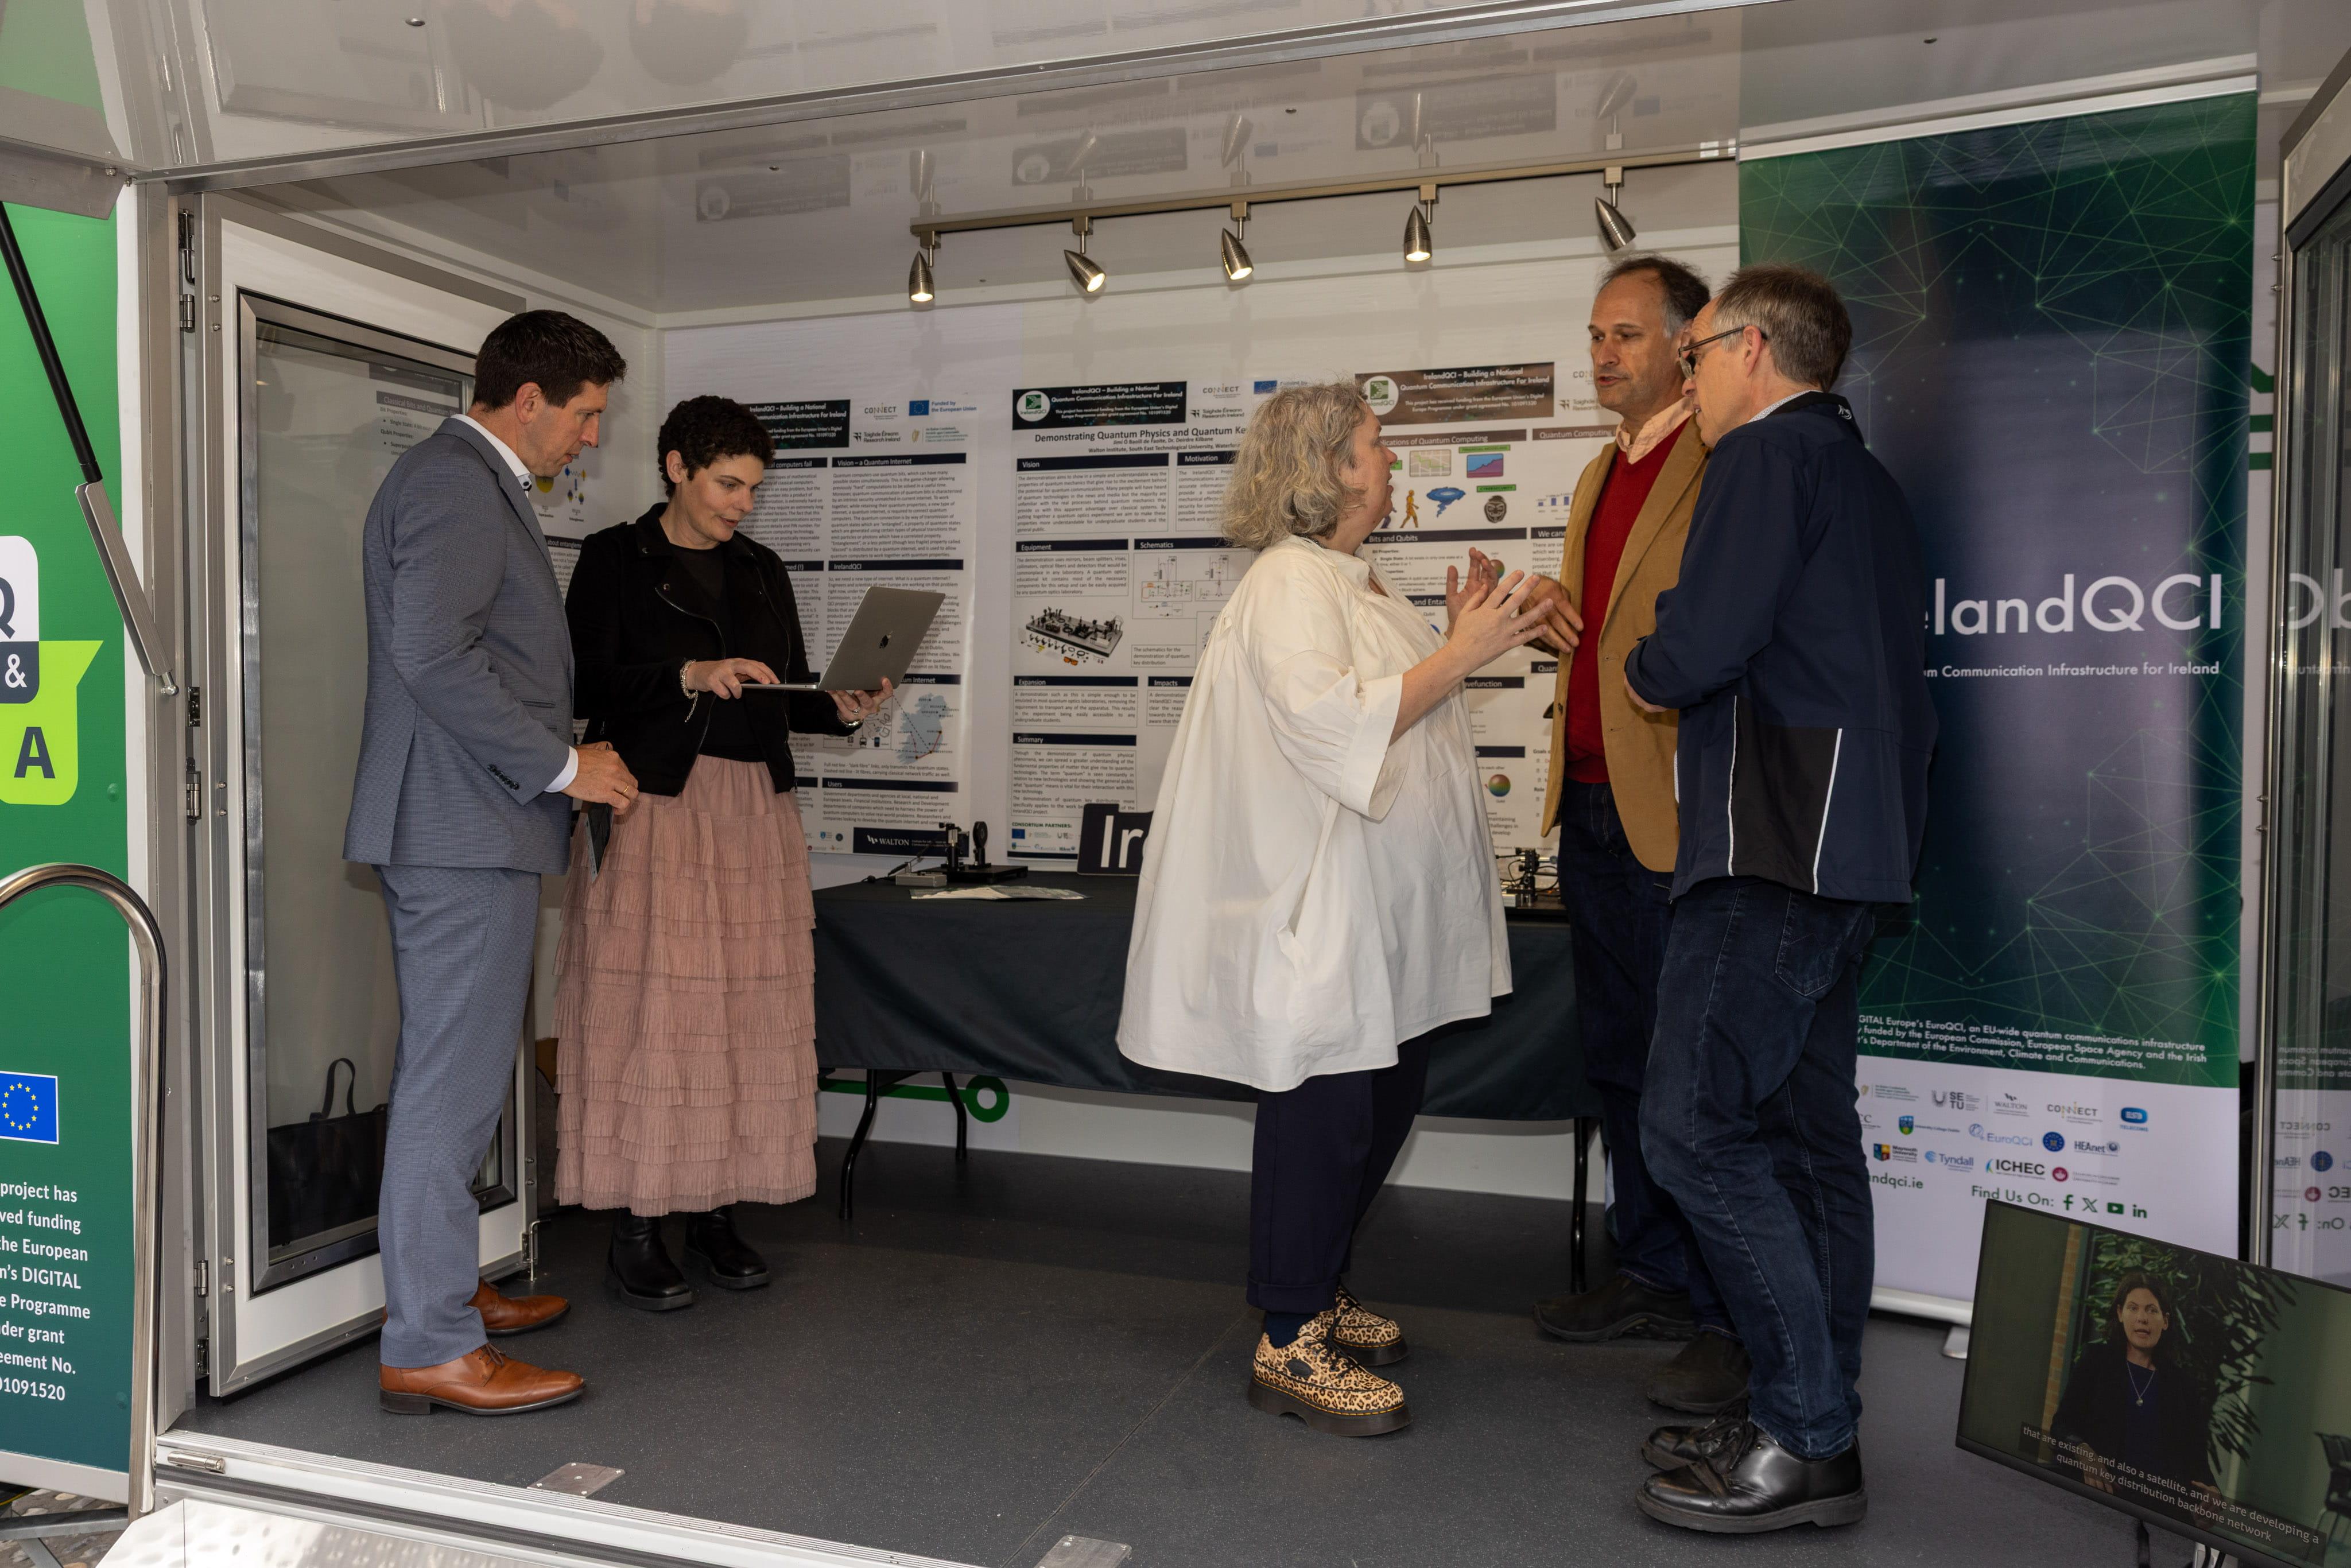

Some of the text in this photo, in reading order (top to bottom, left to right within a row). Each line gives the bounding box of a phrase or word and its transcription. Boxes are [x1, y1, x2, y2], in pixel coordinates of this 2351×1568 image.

[1202, 386, 1239, 394] CONNECT
[864, 406, 897, 414] CONNECT
[1034, 432, 1095, 442] Demonstrating
[1096, 431, 1138, 440] Quantum
[1139, 429, 1170, 438] Physics
[1172, 428, 1189, 436] and
[1191, 428, 1232, 436] Quantum
[1419, 437, 1450, 445] Quantum
[1452, 435, 1488, 443] Computing
[1021, 544, 1052, 552] Equipment
[1925, 573, 2222, 635] landQCI
[5, 654, 27, 688] &
[1941, 665, 2043, 677] Communication
[2047, 663, 2139, 676] Infrastructure
[2142, 661, 2164, 674] for
[2168, 661, 2220, 674] Ireland
[1018, 736, 1043, 744] Summary
[14, 727, 56, 779] A
[879, 837, 909, 846] WALTON
[1886, 1017, 1923, 1028] Europe's
[1925, 1020, 1966, 1031] EuroQCI,
[1983, 1025, 2019, 1035] EU-wide
[2064, 1034, 2139, 1045] communications
[2141, 1038, 2205, 1050] infrastructure
[1864, 1026, 1892, 1035] funded
[1895, 1028, 1906, 1038] by
[1908, 1030, 1922, 1038] the
[1925, 1031, 1966, 1042] European
[1969, 1035, 2024, 1047] Commission,
[2027, 1039, 2071, 1050] European
[2074, 1043, 2103, 1053] Space
[2106, 1047, 2142, 1058] Agency
[2167, 1051, 2182, 1060] the
[2186, 1053, 2206, 1061] Irish
[1870, 1037, 1919, 1047] Department
[1933, 1042, 1946, 1050] the
[1949, 1044, 2005, 1056] Environment,
[2008, 1049, 2042, 1059] Climate
[2066, 1054, 2145, 1068] Communications.
[1949, 1091, 1964, 1101] SE
[1950, 1100, 1965, 1109] TU
[1995, 1101, 2028, 1110] WALTON
[2047, 1103, 2098, 1117] CONNECT
[1987, 1132, 2033, 1146] EuroQCI
[2074, 1140, 2105, 1152] HEAnet
[1939, 1154, 1974, 1166] Tyndall
[1996, 1159, 2046, 1175] ICHEC
[0, 1182, 77, 1202] project has
[1972, 1185, 2054, 1207] Find Us On:
[27, 1212, 81, 1234] funding
[22, 1239, 88, 1260] European
[22, 1267, 81, 1288] DIGITAL
[11, 1294, 90, 1318] Programme
[28, 1328, 65, 1344] grant
[52, 1356, 76, 1373] No.
[2023, 1426, 2319, 1544] that are existing, and also a satellite, and we are developing a
[2056, 1454, 2271, 1541] quantum key distribution backbone network
